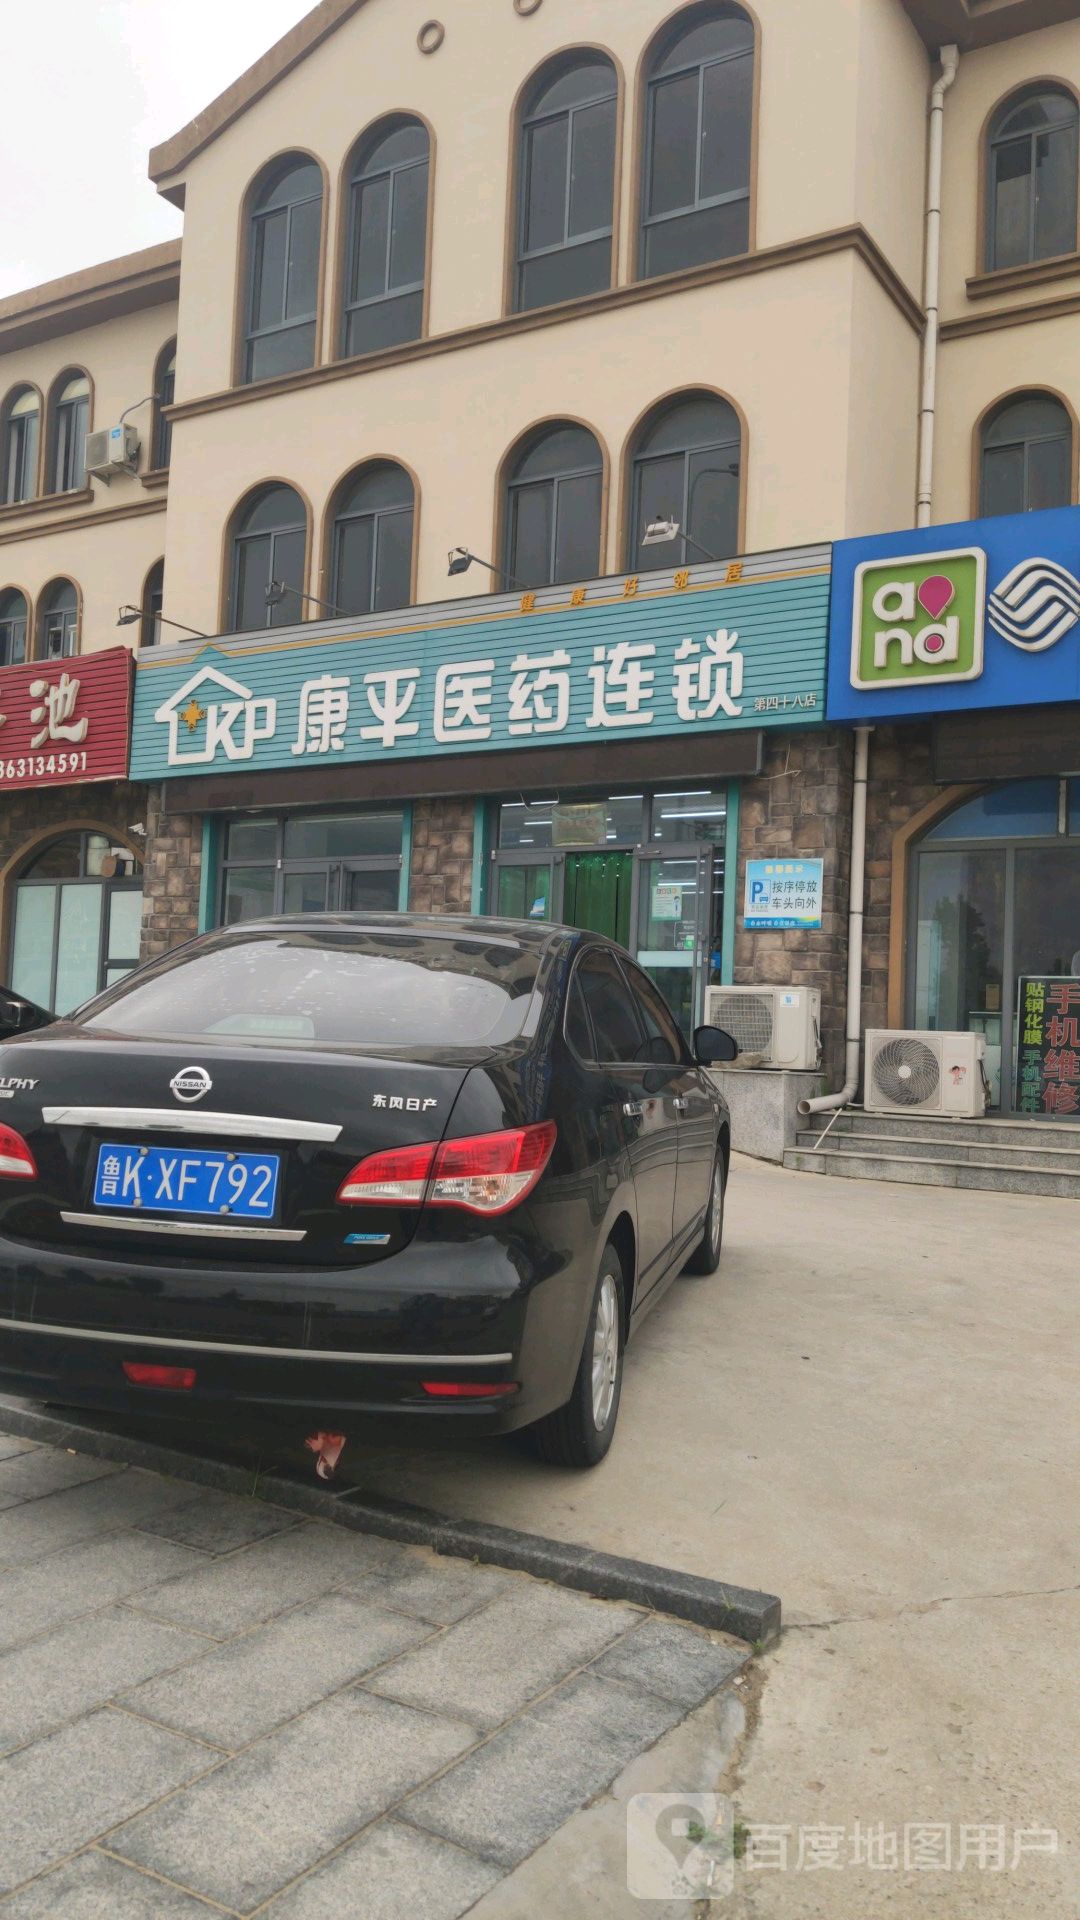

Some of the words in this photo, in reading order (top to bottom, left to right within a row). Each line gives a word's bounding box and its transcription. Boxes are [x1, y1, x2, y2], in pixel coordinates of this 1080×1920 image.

[520, 561, 744, 612] 健康好邻居
[291, 628, 745, 755] 康平医药连锁
[753, 692, 817, 712] 第四十八店
[772, 880, 818, 894] 按序停放
[772, 897, 817, 910] 车头向外
[1023, 982, 1045, 1046] 贴钢化膜
[1042, 982, 1080, 1115] 手机维修
[173, 1080, 207, 1088] NISSAN
[1020, 1049, 1042, 1113] 手机配件
[372, 1094, 438, 1112] 东风日产
